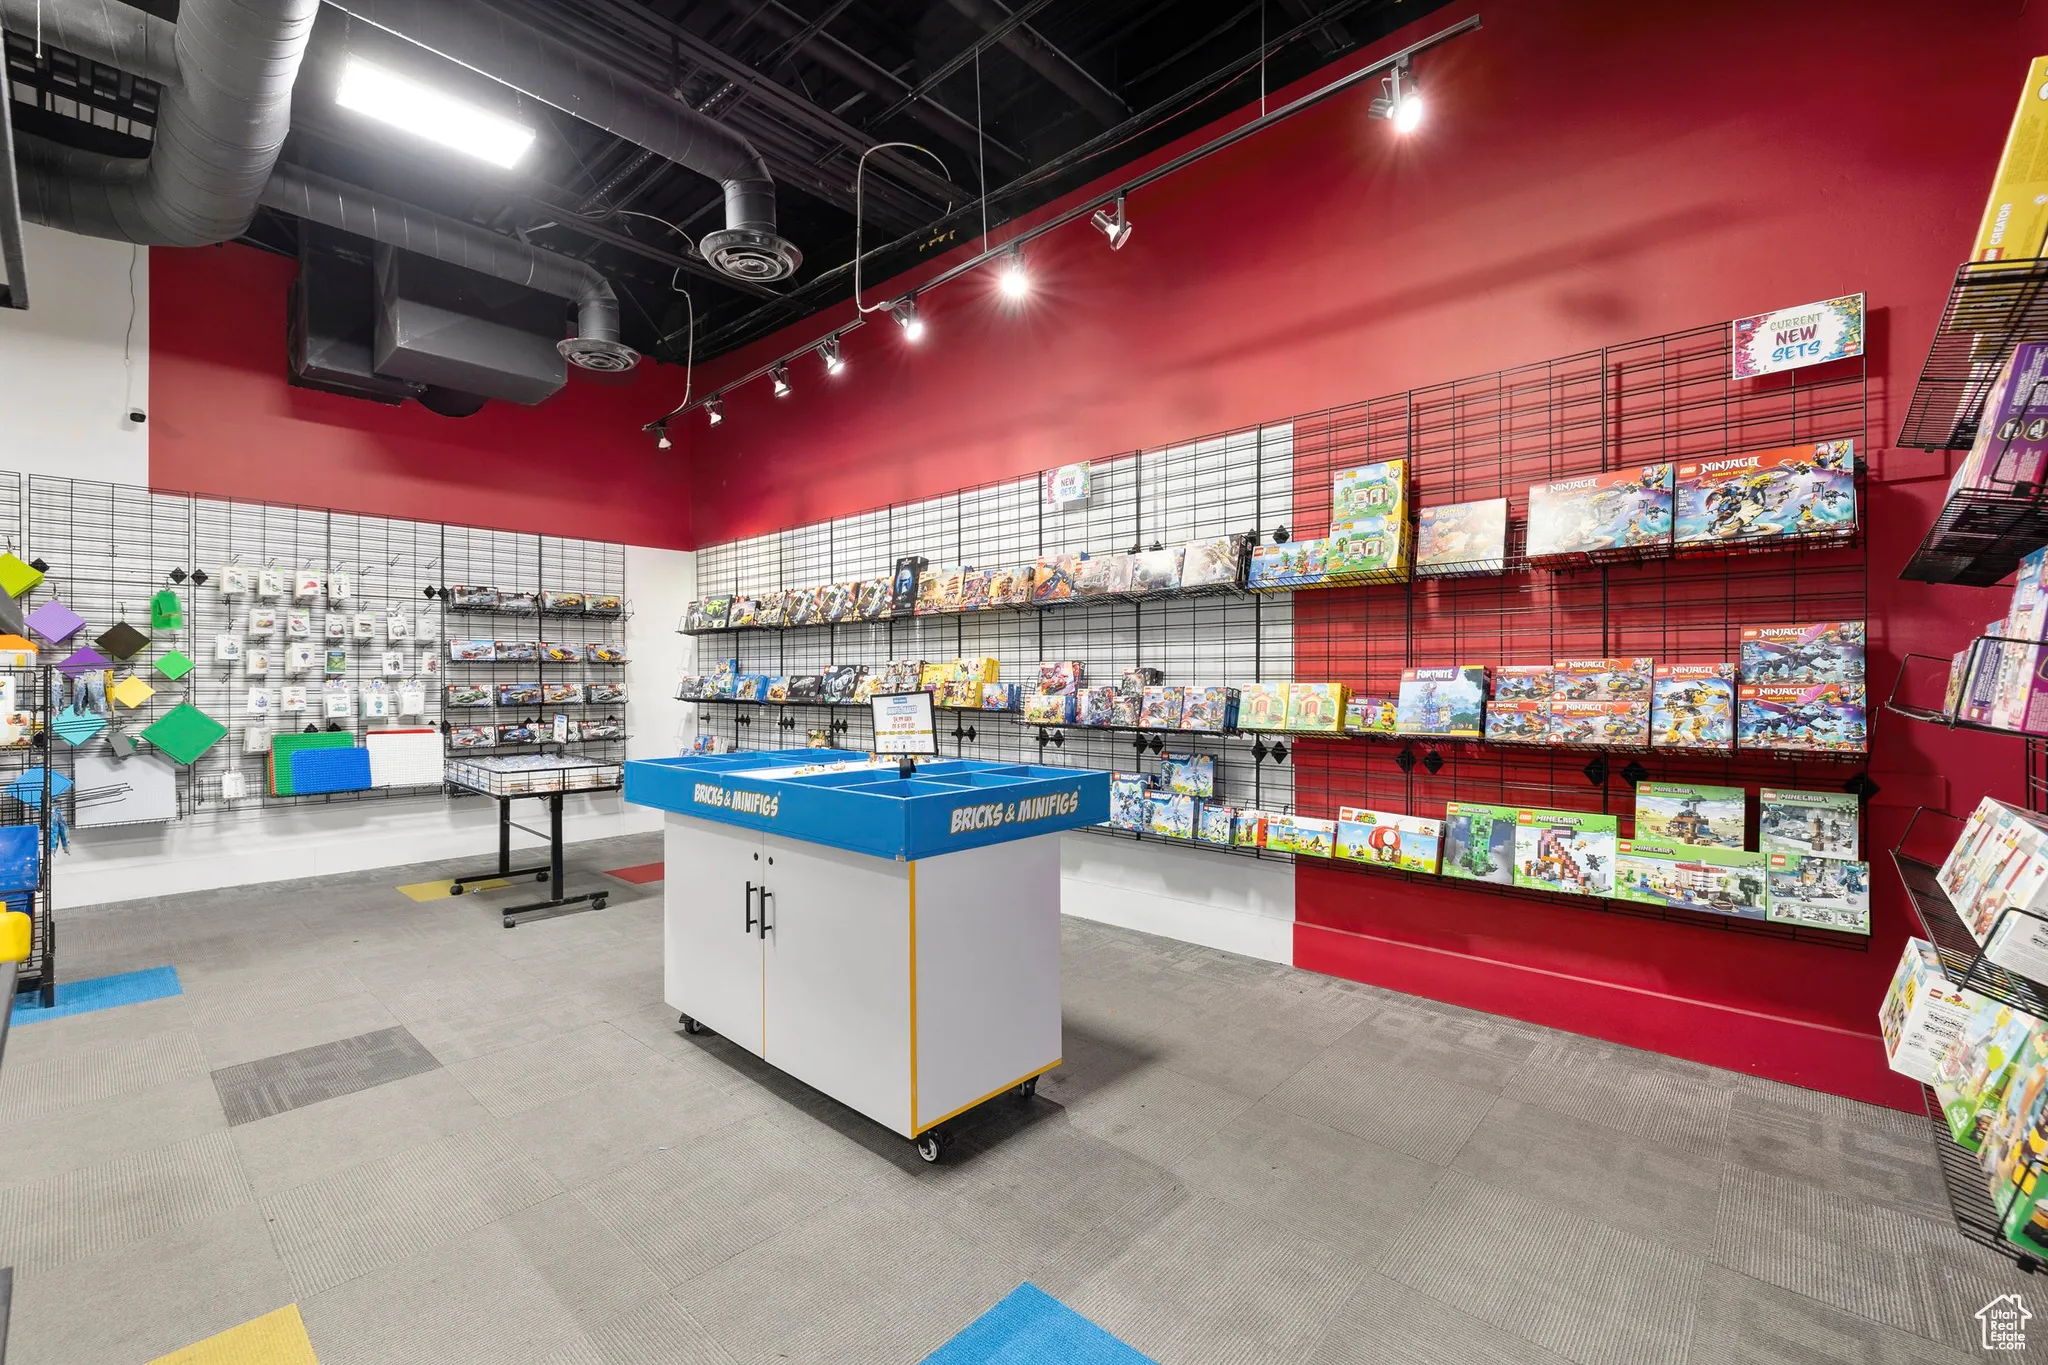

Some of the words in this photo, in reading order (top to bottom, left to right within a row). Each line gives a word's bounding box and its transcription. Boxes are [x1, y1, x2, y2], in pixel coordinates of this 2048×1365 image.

[1990, 203, 2012, 245] CREATOR
[1770, 312, 1822, 331] CURRENT
[1776, 324, 1817, 346] NEW
[1772, 340, 1821, 362] SETS
[1679, 466, 1696, 474] LEGO
[1699, 456, 1763, 475] NINJAGO
[1061, 476, 1075, 487] NEW
[1549, 478, 1598, 495] NINJAGO
[1060, 486, 1077, 496] SETS
[1759, 627, 1810, 639] NINJAGO
[1568, 661, 1609, 669] NINJAGO
[1417, 669, 1454, 679] FORTNITE
[1757, 687, 1808, 697] NINJAGO
[1565, 703, 1606, 711] NINJAGO
[1653, 786, 1696, 795] MINECRAFT
[694, 783, 724, 807] BRICKS
[724, 790, 731, 807] &
[731, 790, 779, 817] MINIFIGS
[1780, 793, 1831, 803] MINECRAFT
[950, 803, 1004, 834] BRICKS
[1004, 803, 1015, 822] &
[1016, 790, 1079, 822] MINIFIGS
[1460, 806, 1493, 815] MINECRAFT
[1354, 815, 1377, 825] MARIO
[1535, 814, 1585, 826] MINECRAFT
[1633, 844, 1677, 855] MINECRAFT
